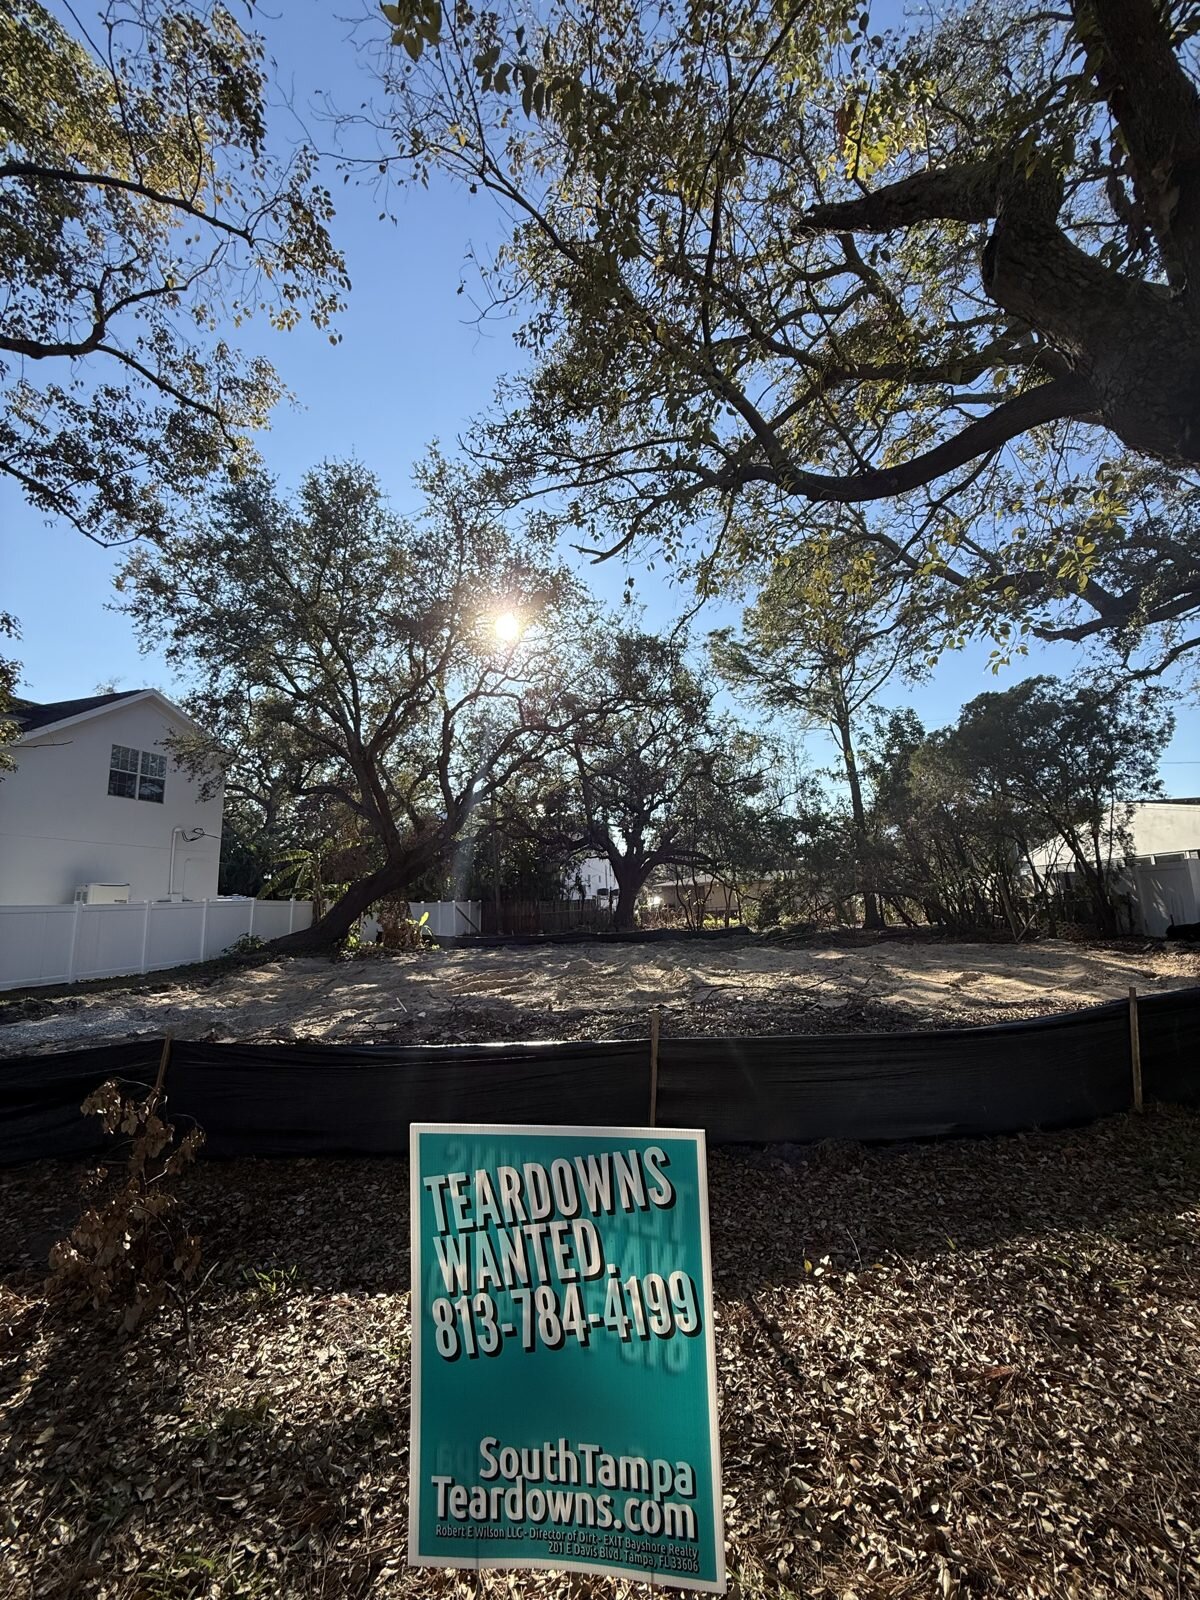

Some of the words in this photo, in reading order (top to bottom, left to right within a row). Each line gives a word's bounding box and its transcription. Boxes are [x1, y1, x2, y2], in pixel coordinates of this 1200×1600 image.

[423, 1146, 672, 1232] TEARDOWNS
[433, 1218, 616, 1293] WANTED.
[432, 1270, 698, 1357] 813-784-4199
[479, 1436, 694, 1501] SouthTampa
[431, 1475, 695, 1539] Teardowns.com
[436, 1524, 465, 1538] Robert
[467, 1526, 473, 1537] E
[475, 1527, 505, 1538] Wilson
[507, 1527, 523, 1538] LLC
[529, 1528, 566, 1541] Director
[567, 1531, 577, 1542] of
[579, 1532, 596, 1544] Dirt
[603, 1535, 622, 1548] EXIT
[625, 1537, 666, 1555] Bayshore
[668, 1543, 698, 1561] Realty
[548, 1542, 563, 1553] 201
[566, 1544, 572, 1554] E
[574, 1544, 598, 1558] Davis
[599, 1547, 622, 1561] Blvd.
[624, 1550, 656, 1568] Tampa,
[659, 1557, 670, 1568] FL
[671, 1558, 699, 1573] 33606
